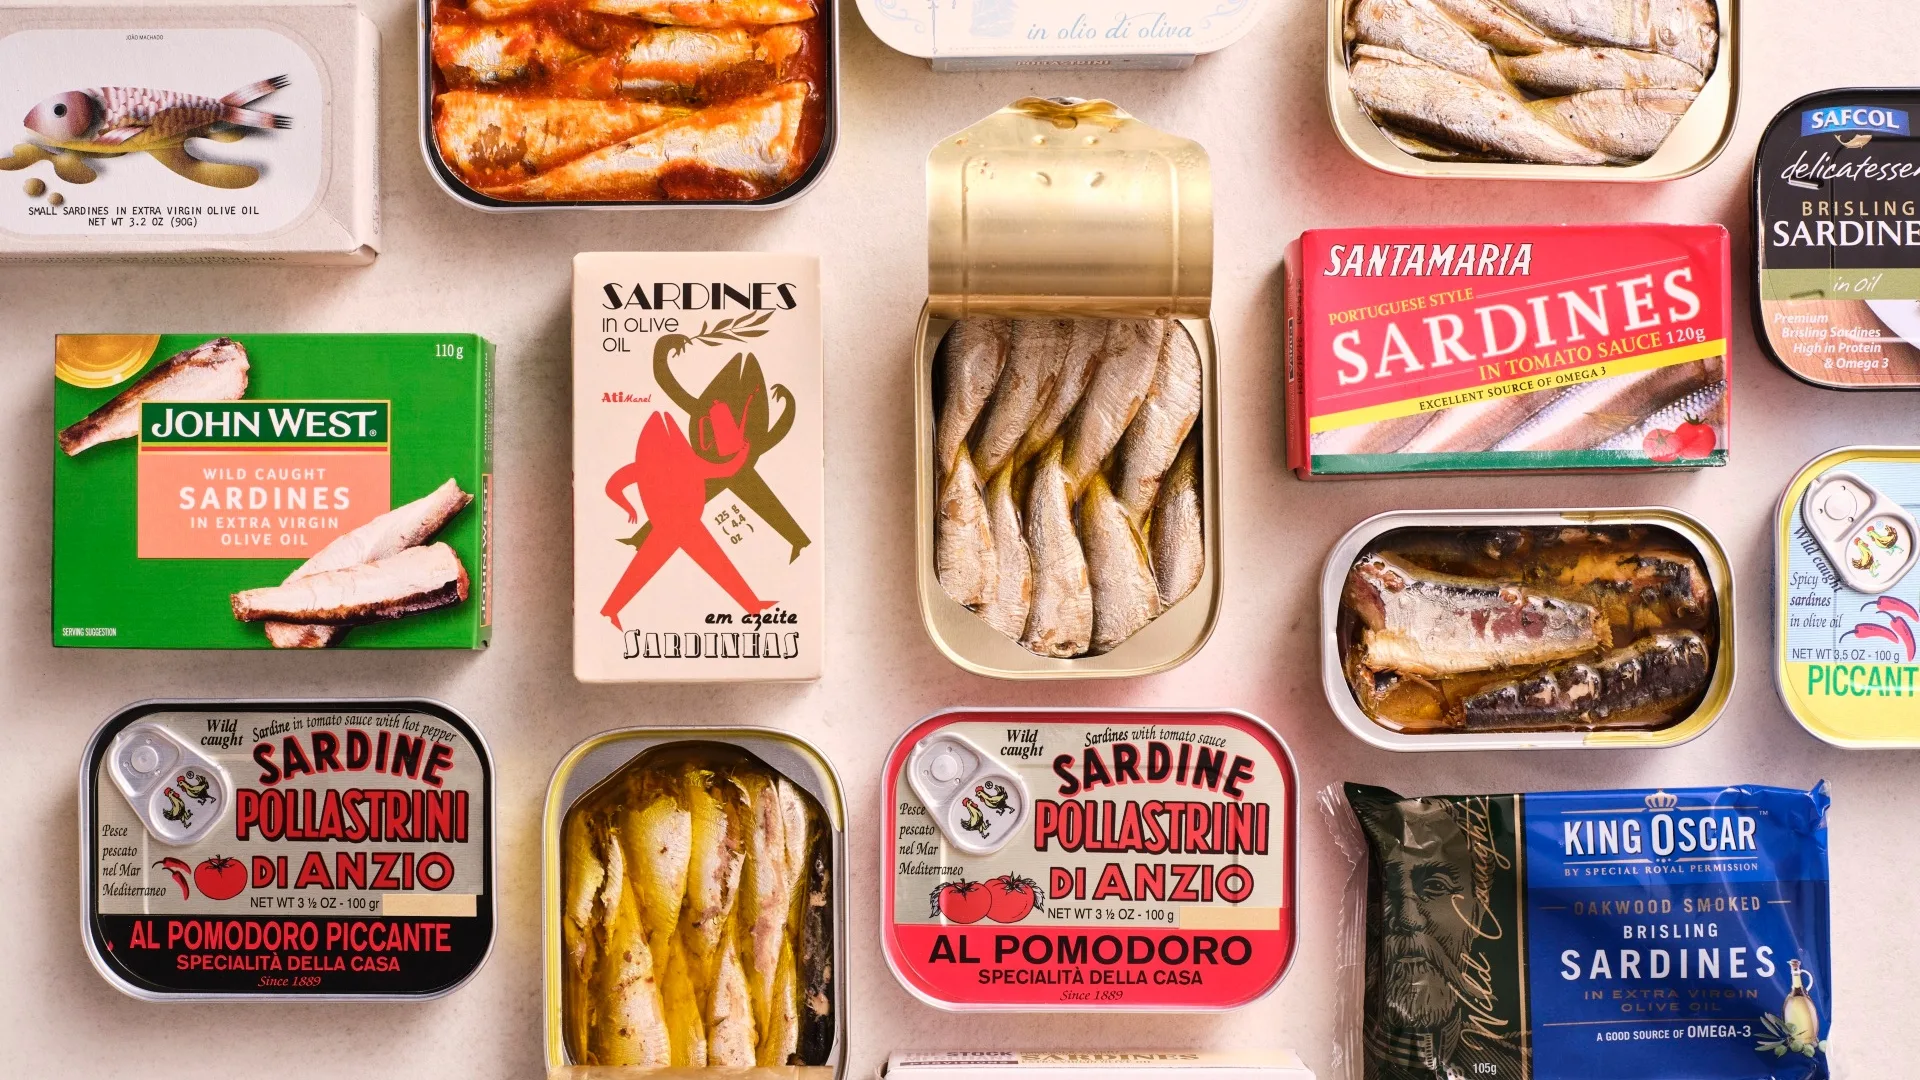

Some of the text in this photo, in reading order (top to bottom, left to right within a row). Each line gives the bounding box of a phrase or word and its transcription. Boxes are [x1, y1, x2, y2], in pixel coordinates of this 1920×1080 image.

[1027, 12, 1193, 40] in olio di oliva
[1812, 109, 1899, 128] SAFCOL
[28, 207, 259, 216] SMALL SARDINES IN EXTRA VIRGIN OLIVE OIL
[1802, 201, 1914, 216] BRISLING
[88, 217, 198, 228] NET WT 3.2 OZ (90G)
[1323, 242, 1533, 277] SANTAMARIA
[1833, 274, 1883, 292] in Oil
[602, 282, 796, 310] SARDINES
[1329, 288, 1474, 326] PORTUGUESE STYLE
[1332, 266, 1700, 386] SARDINES
[1774, 314, 1828, 323] Premium
[1782, 326, 1880, 339] Brisling Sardines
[436, 344, 453, 357] 110
[602, 338, 630, 352] OIL
[1479, 326, 1706, 380] IN TOMATO SAUCE 120g
[1794, 342, 1881, 355] High in Protein
[1837, 358, 1878, 371] Omega
[1419, 368, 1598, 410] EXCELLENT SOURCE OF OMEGA
[151, 408, 377, 438] JOHN WEST
[203, 468, 326, 480] WILD CAUGHT
[180, 486, 350, 510] SARDINES
[191, 517, 338, 528] IN EXTRA VIRGIN
[715, 510, 730, 525] 125
[732, 514, 746, 528] 4.4
[221, 533, 308, 546] OLIVE OIL
[1794, 526, 1843, 592] Wild caught
[1790, 572, 1818, 589] Spicy
[1790, 592, 1831, 607] sardines
[705, 608, 797, 631] em azeite
[1790, 614, 1843, 628] in olive oil
[62, 628, 116, 637] SERVING SUGGESTION
[624, 629, 799, 659] SARDINHAS
[1793, 649, 1891, 661] NET WT 3,5 OZ 100
[1808, 665, 1918, 696] PICCANT
[206, 718, 238, 733] Wild
[252, 714, 457, 744] Sardine in tomato sauce with hot pepper
[201, 733, 243, 750] caught
[1006, 729, 1038, 743] Wild
[1084, 726, 1227, 748] Sardines with tomato sauce
[252, 729, 454, 788] SARDINE
[1000, 744, 1043, 760] caught
[1052, 742, 1255, 801] SARDINE
[236, 788, 470, 844] POLLASTRINI
[900, 803, 925, 816] Pesce
[102, 824, 128, 837] Pesce
[900, 824, 935, 837] pescato
[1034, 799, 1270, 855] POLLASTRINI
[1564, 814, 1756, 856] KING OSCAR
[102, 846, 137, 859] pescato
[103, 864, 141, 876] nel Mar
[251, 852, 455, 891] DI ANZIO
[899, 862, 963, 876] Mediterraneo
[1586, 866, 1638, 875] SPECIAL
[1646, 865, 1684, 874] ROYAL
[1691, 863, 1757, 872] PERMISSION
[102, 884, 166, 896] Mediterraneo
[1049, 864, 1254, 903] DI ANZIO
[250, 897, 366, 908] NET WT OZ 100
[1574, 897, 1760, 915] OAKWOOD SMOKED
[1448, 796, 1510, 1050] Wild Caught
[1623, 923, 1718, 939] BRISLING
[130, 920, 452, 952] AL POMODORO PICCANTE
[928, 934, 1252, 965] AL POMODORO
[177, 952, 400, 971] SPECIALITÀ DELLA CASA
[1561, 946, 1775, 980] SARDINES
[258, 976, 321, 987] Since 1889
[978, 966, 1203, 985] SPECIALITÀ DELLA CASA
[1585, 990, 1757, 1000] IN EXTRA VIRGIN
[1622, 1002, 1721, 1012] OLIVE OIL
[1606, 1025, 1751, 1041] GOOD SOURCE OF OMEGA-3
[1472, 1063, 1497, 1075] 105g
